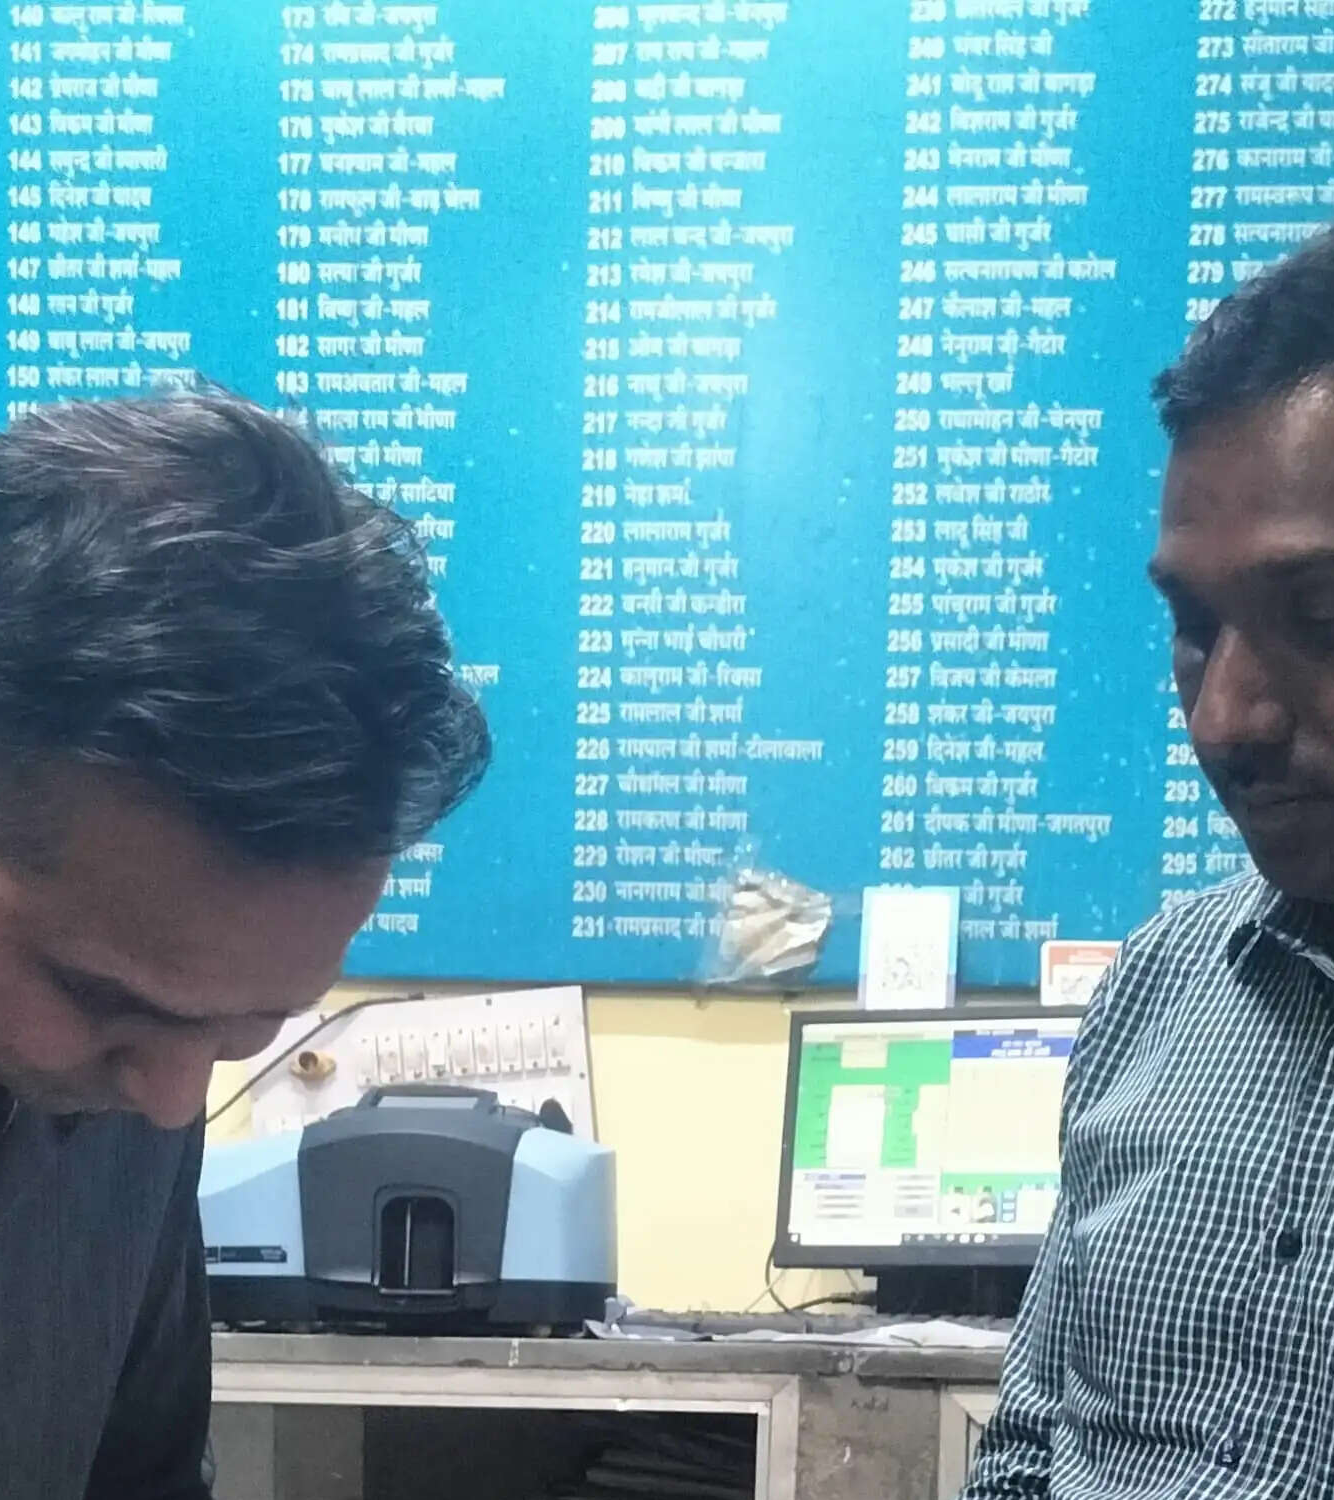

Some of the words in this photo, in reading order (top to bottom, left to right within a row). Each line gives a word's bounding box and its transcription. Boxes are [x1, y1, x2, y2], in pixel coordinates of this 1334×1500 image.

[1198, 37, 1234, 58] 273
[1196, 74, 1232, 96] 274
[1274, 66, 1298, 91] जी
[1194, 111, 1231, 133] 275
[1292, 103, 1315, 128] जी
[1193, 149, 1229, 171] 276
[275, 335, 309, 357] 182
[360, 330, 382, 355] जी
[276, 371, 308, 395] 183
[582, 484, 616, 507] 219
[581, 522, 615, 543] 220
[890, 556, 925, 578] 254
[981, 551, 1004, 578] जी
[579, 630, 612, 652] 223
[577, 702, 610, 724] 225
[685, 697, 706, 722] जी
[885, 703, 919, 724] 258
[576, 738, 610, 760] 226
[679, 733, 702, 758] जी
[883, 739, 919, 760] 259
[883, 775, 917, 796] 260
[975, 771, 998, 796] जी
[1164, 780, 1200, 802] 293
[575, 810, 608, 831] 228
[684, 806, 706, 829] जी
[881, 811, 914, 832] 261
[972, 807, 995, 832] जी
[1163, 816, 1198, 838] 294
[880, 847, 914, 868] 262
[966, 843, 988, 868] जी
[1162, 853, 1197, 875] 295
[573, 881, 607, 902] 230
[685, 876, 707, 901] जी
[964, 880, 984, 905] जी
[572, 916, 604, 937] 231
[683, 912, 705, 936] जी
[998, 914, 1021, 939] जी
